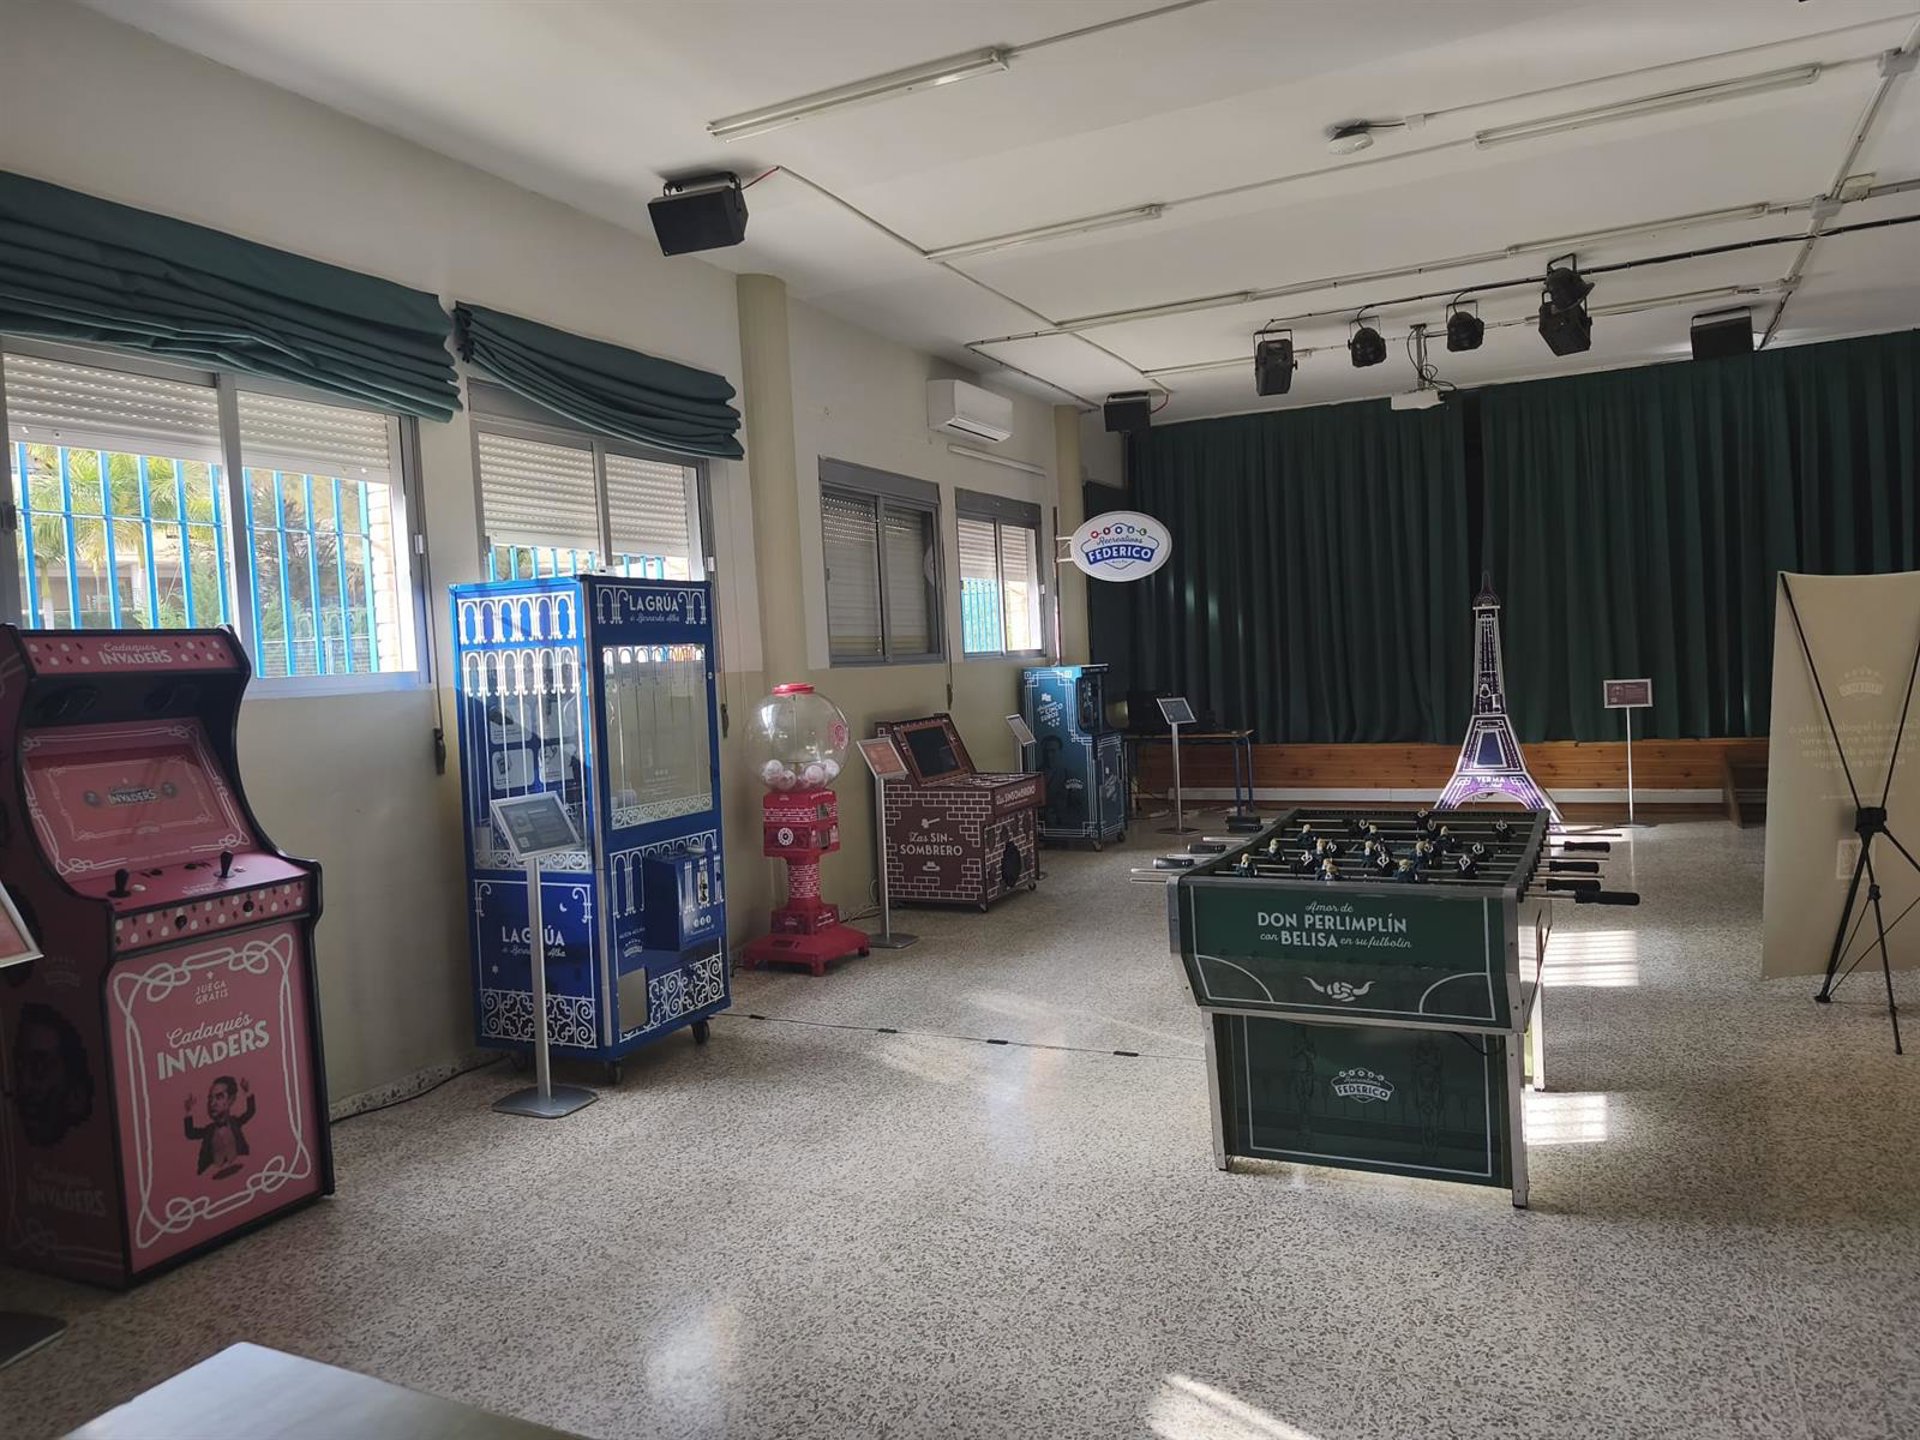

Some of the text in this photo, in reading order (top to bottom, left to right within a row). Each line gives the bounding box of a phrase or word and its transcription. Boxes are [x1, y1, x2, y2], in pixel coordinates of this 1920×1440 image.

[1088, 546, 1152, 563] FEDERICO
[98, 649, 173, 665] INVADERS
[900, 844, 963, 856] SOMBRERO
[1304, 901, 1354, 913] Amor de
[1257, 912, 1407, 933] DON PERLIMPLÍN
[1281, 930, 1338, 948] BELISA
[196, 980, 226, 996] JUEGA
[195, 989, 230, 1005] GRATIS
[166, 1011, 253, 1048] Cadaqués
[157, 1020, 270, 1080] INVADERS
[1337, 1085, 1389, 1098] FEDERICO
